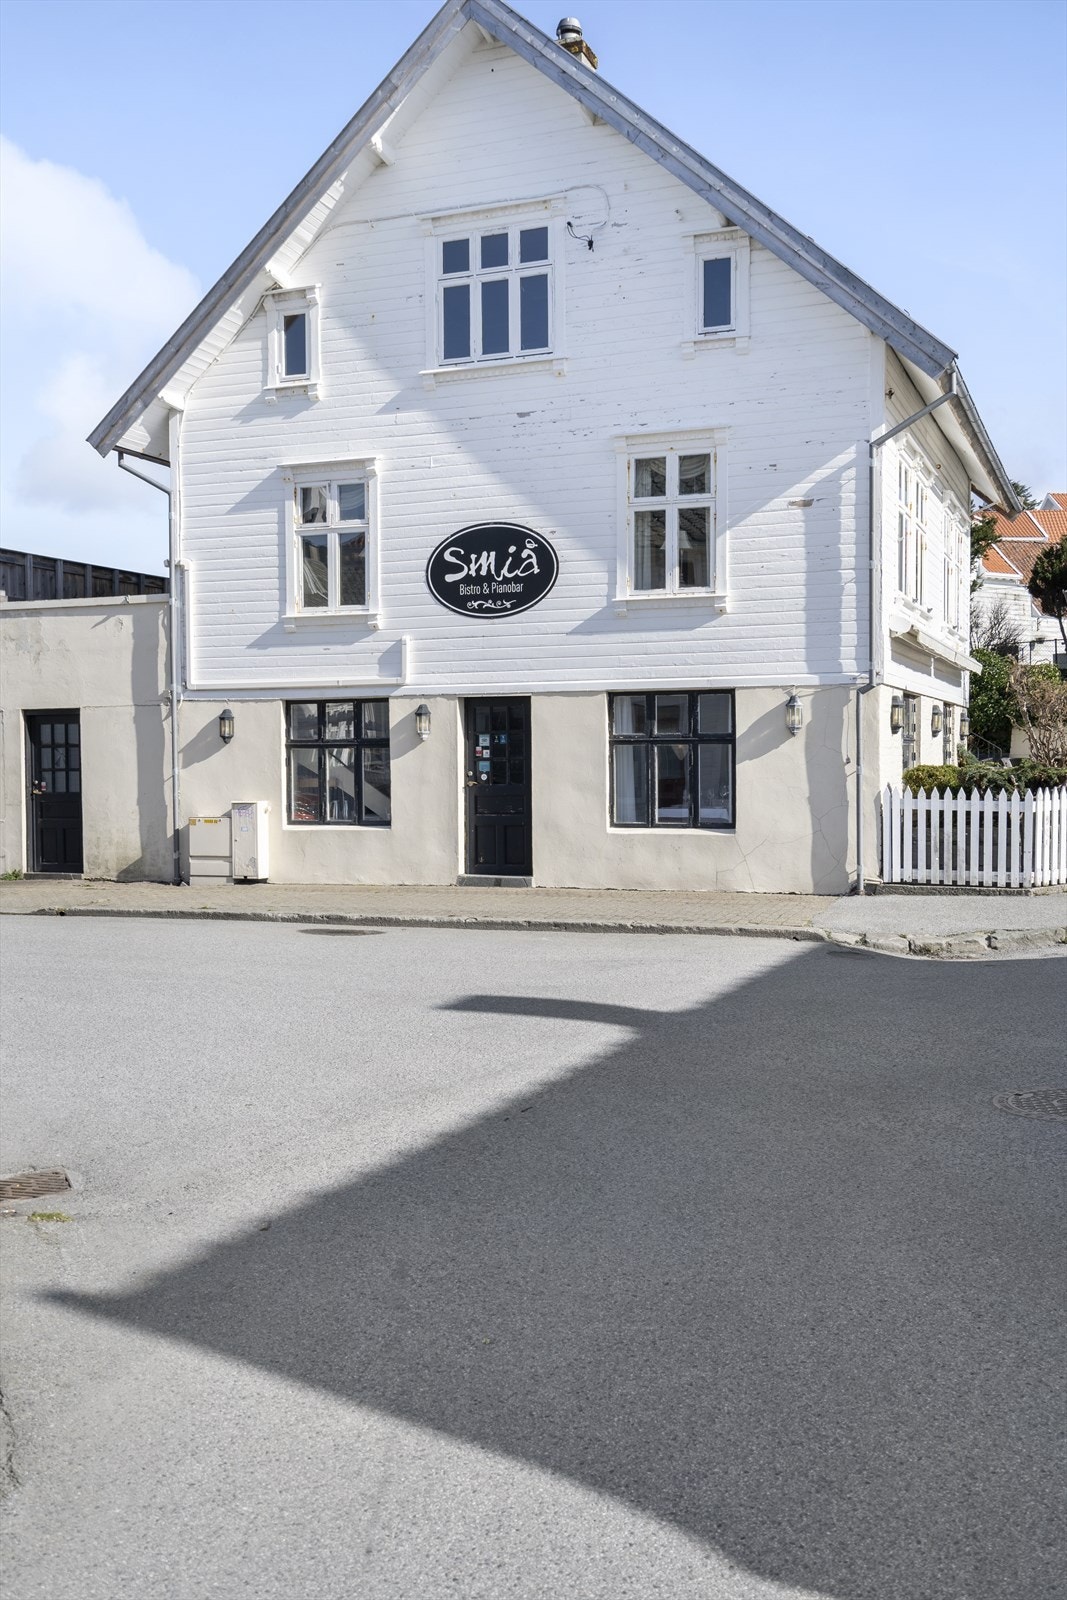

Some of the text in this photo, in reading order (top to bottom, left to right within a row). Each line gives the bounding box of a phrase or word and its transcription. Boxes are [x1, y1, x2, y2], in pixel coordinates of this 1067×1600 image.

[443, 538, 540, 582] Smiå
[459, 582, 524, 595] Bistro & Pianobar
